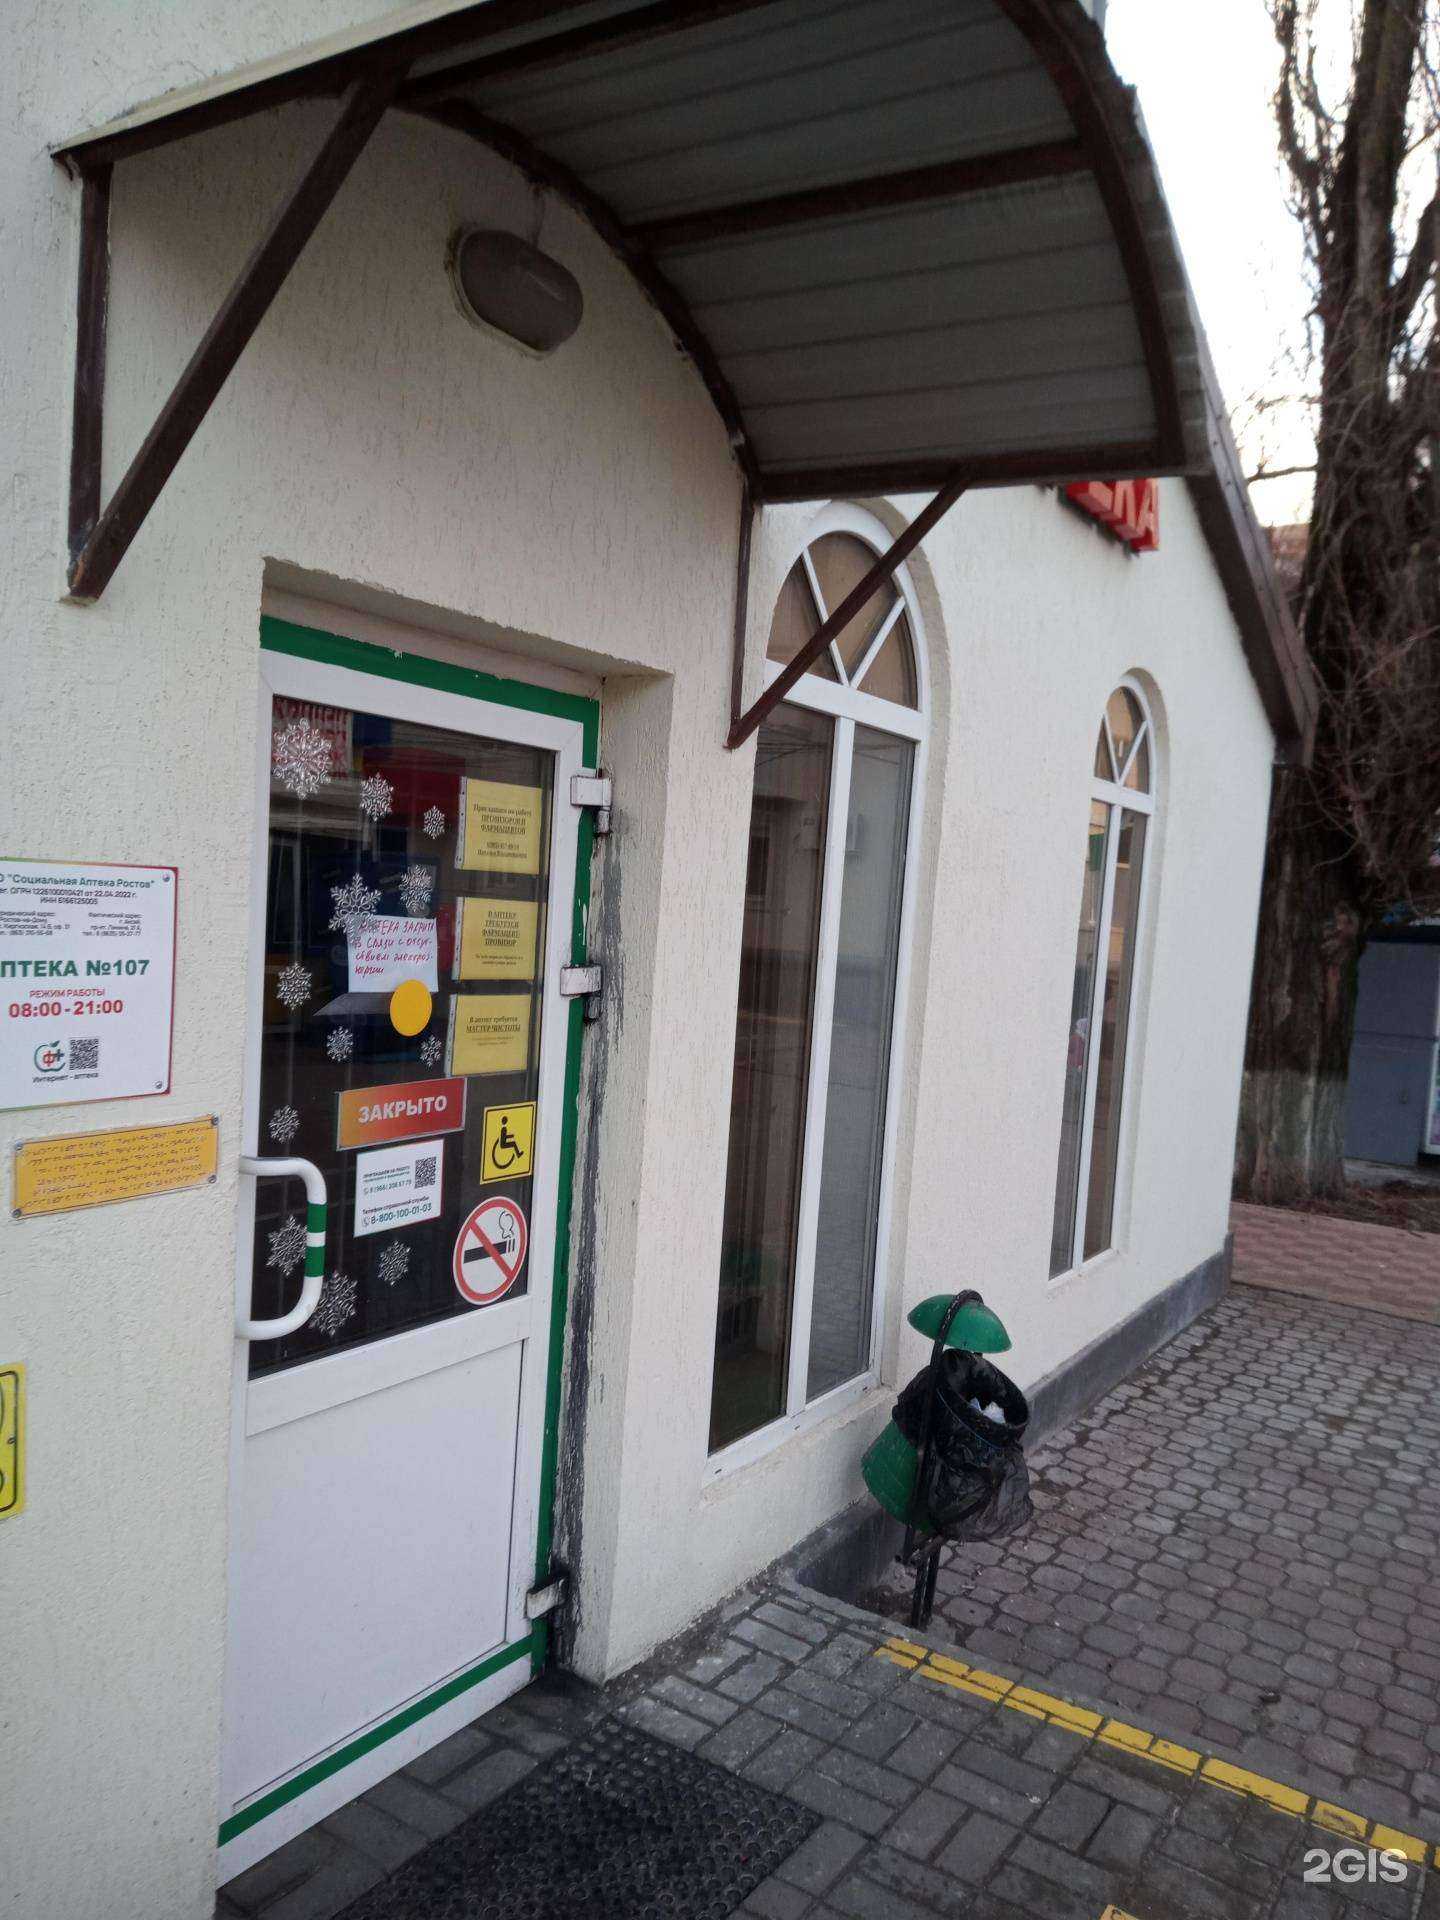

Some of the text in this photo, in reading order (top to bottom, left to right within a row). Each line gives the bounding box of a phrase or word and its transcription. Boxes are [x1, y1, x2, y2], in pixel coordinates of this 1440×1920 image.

[79, 877, 115, 888] Аптека
[40, 897, 57, 905] ИНН
[86, 959, 150, 976] №107
[29, 988, 105, 998] РЕЖИМ РАБОТЫ
[358, 1095, 448, 1124] ЗАКРЫТО
